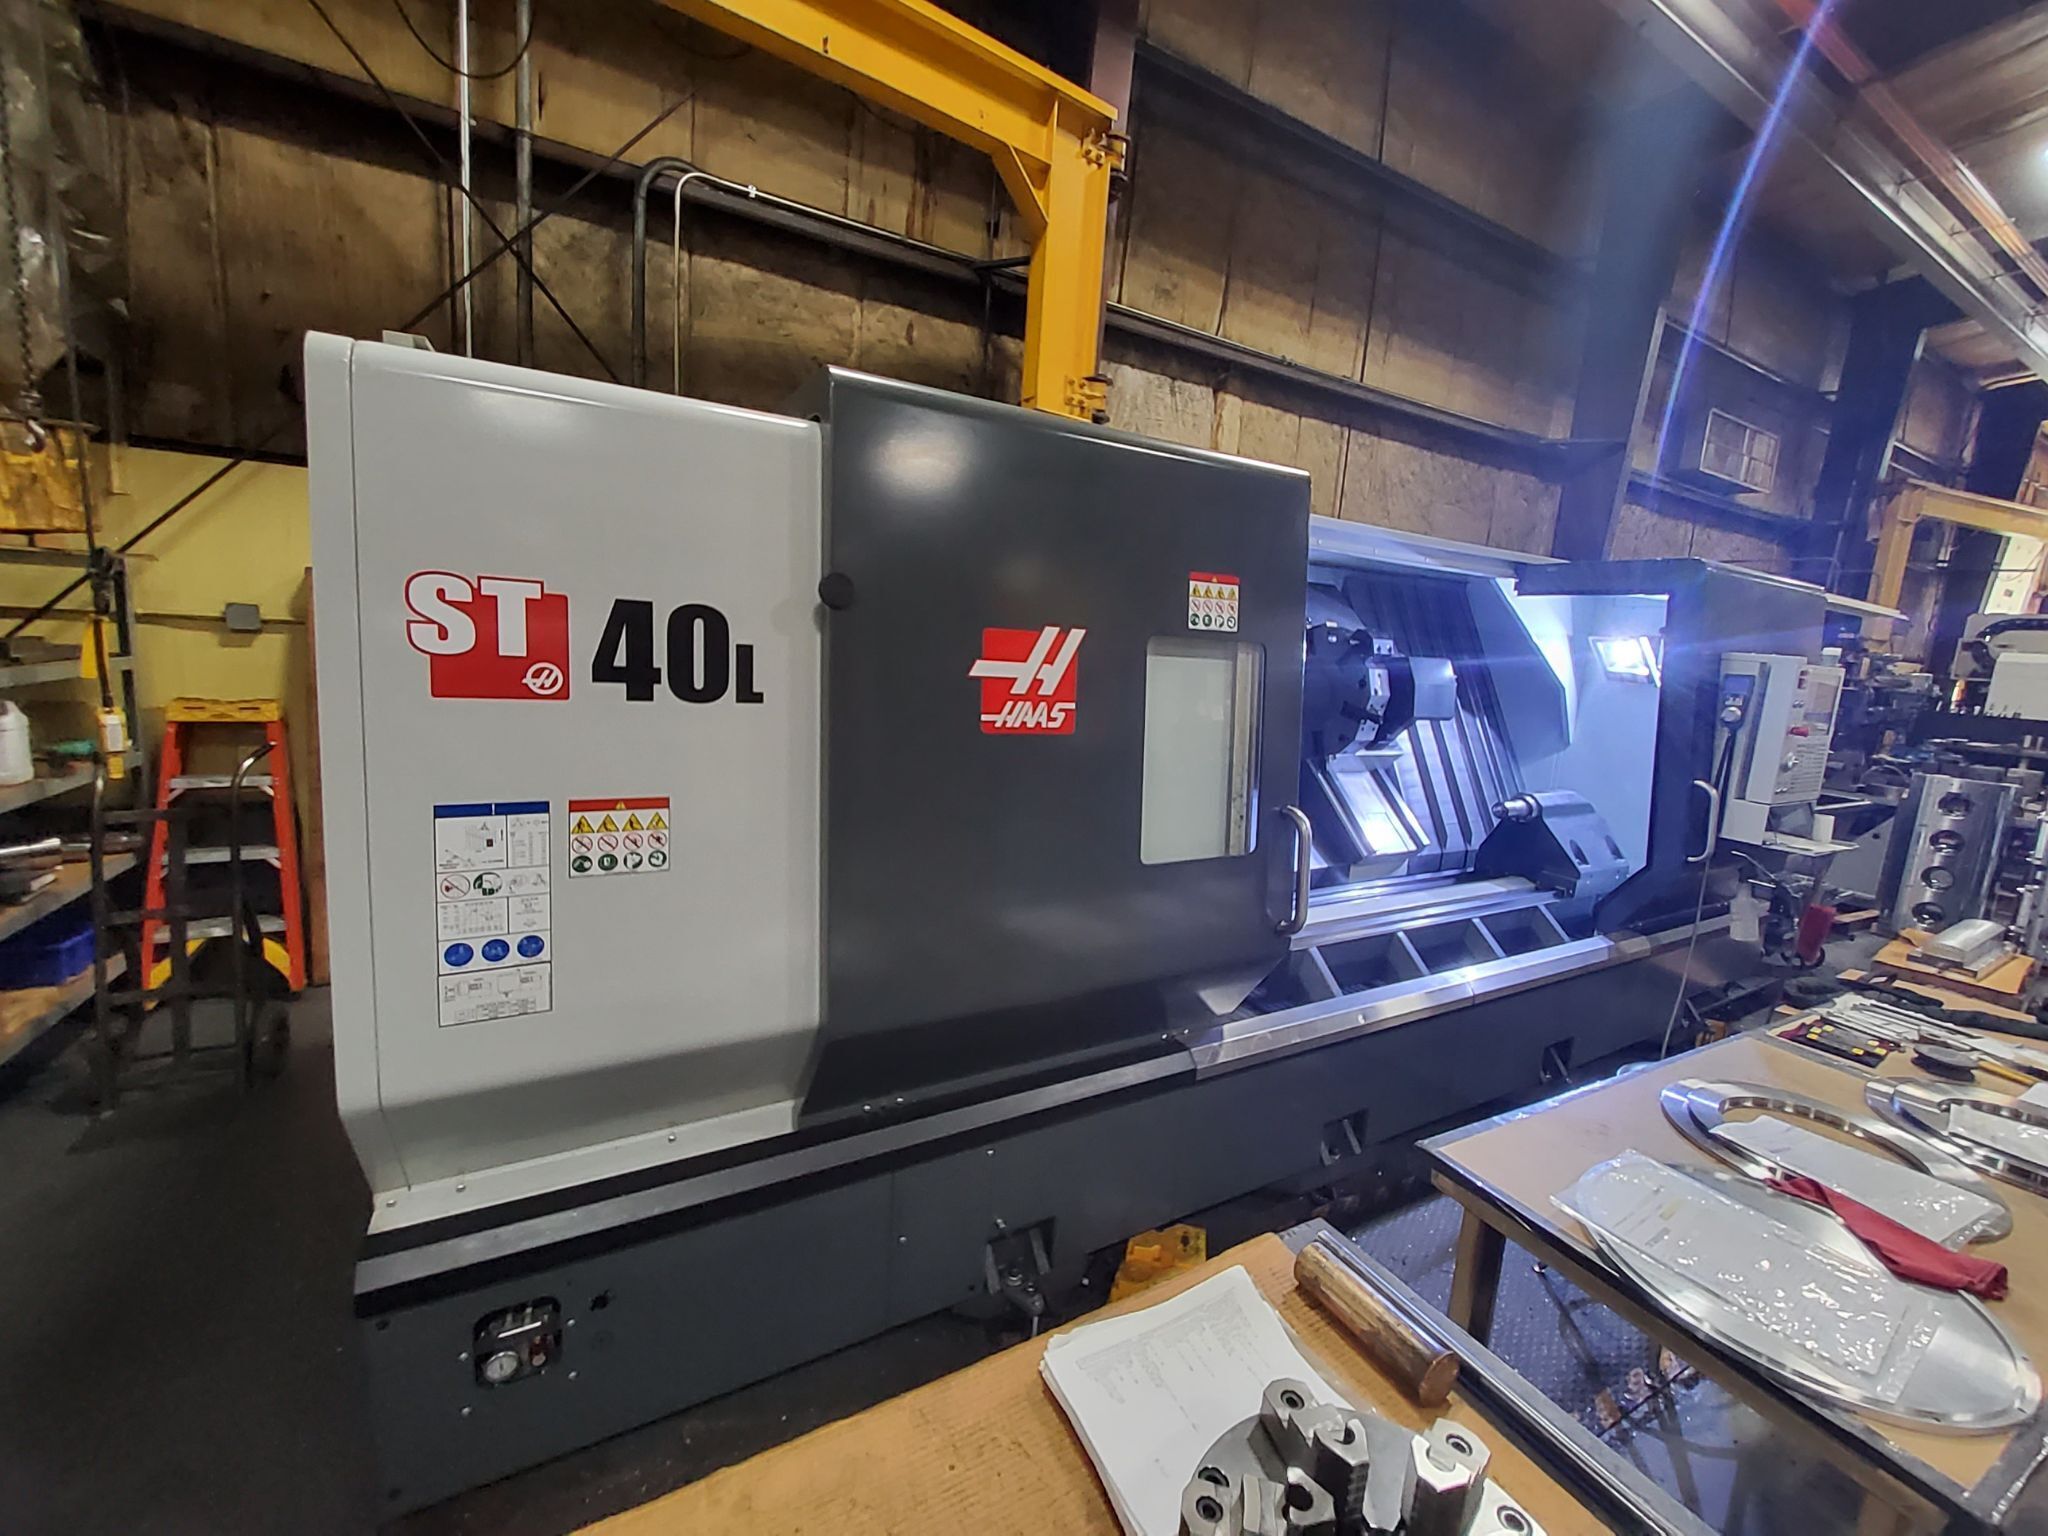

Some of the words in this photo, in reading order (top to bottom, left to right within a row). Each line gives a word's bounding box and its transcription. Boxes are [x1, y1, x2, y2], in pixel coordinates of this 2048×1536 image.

[405, 570, 543, 657] ST
[591, 598, 764, 704] 40L
[981, 700, 1076, 729] HAAS
